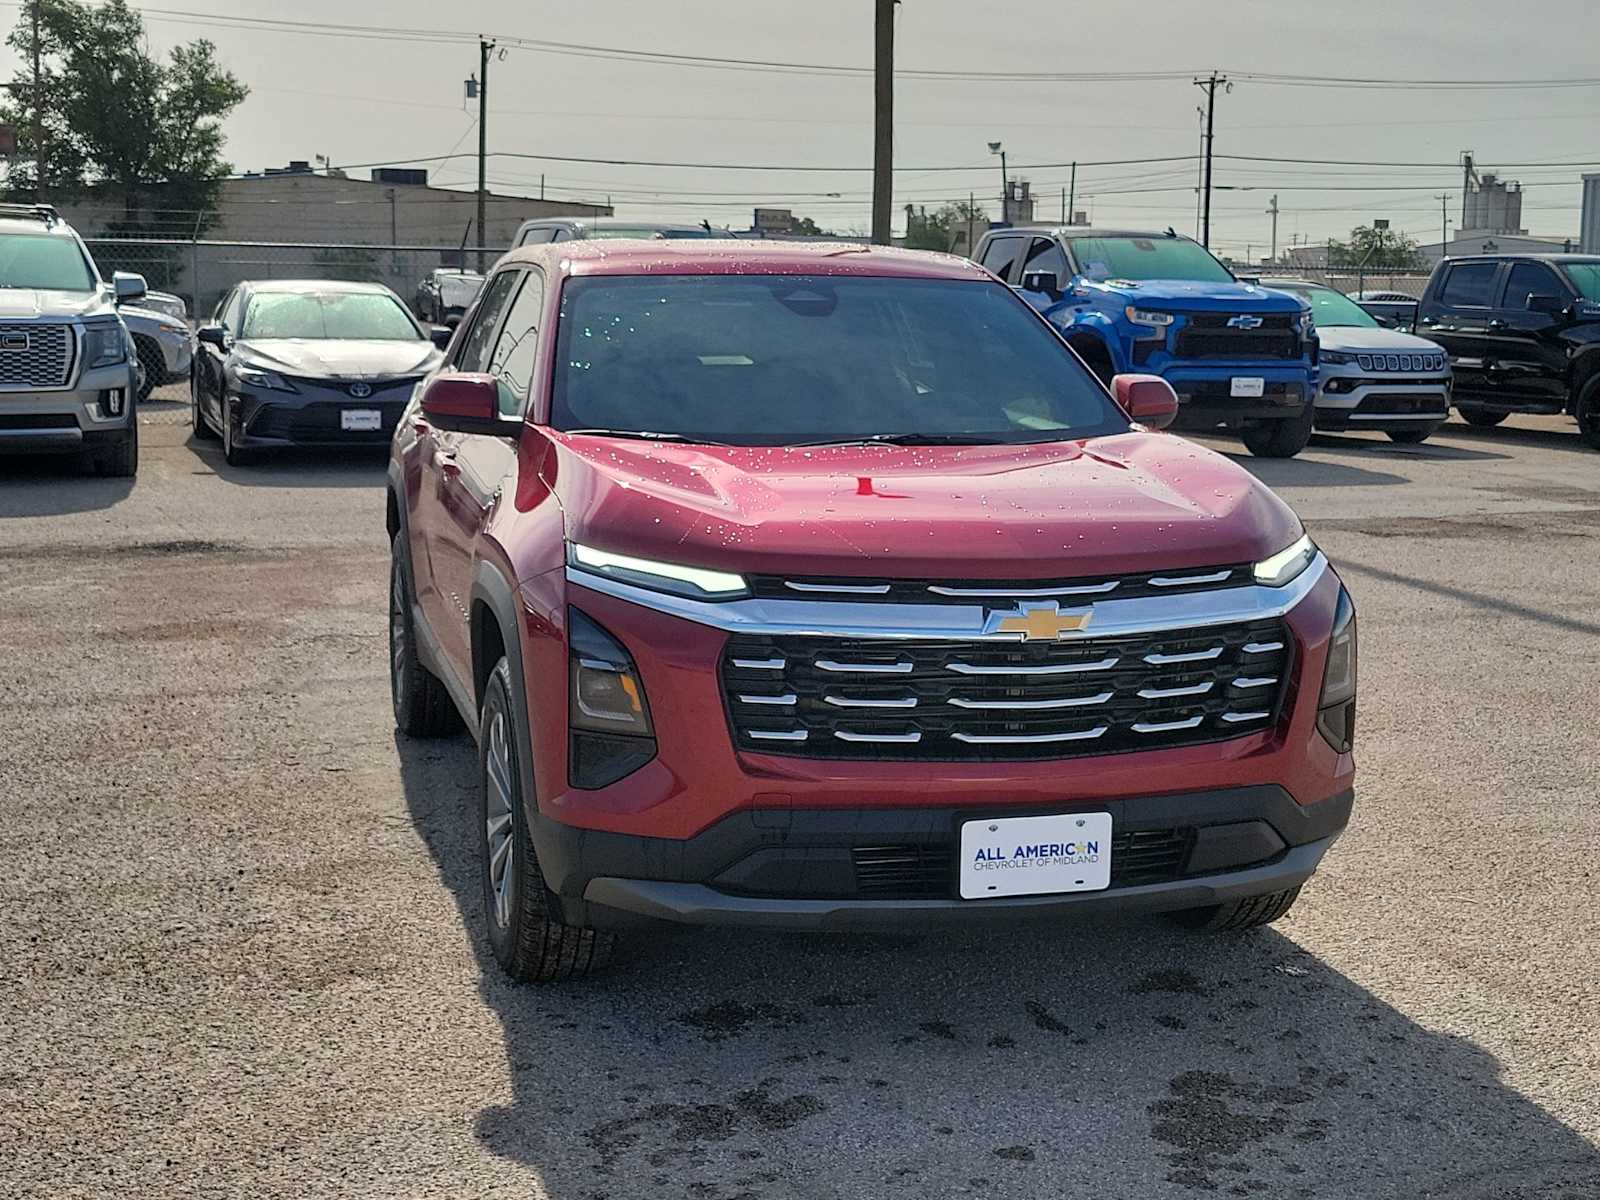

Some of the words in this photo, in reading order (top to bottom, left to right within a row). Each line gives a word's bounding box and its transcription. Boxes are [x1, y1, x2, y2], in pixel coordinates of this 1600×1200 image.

[975, 848, 1006, 862] ALL
[974, 858, 1034, 871] CHEVROLET
[1036, 857, 1050, 867] OF
[1053, 855, 1099, 865] MIDLAND
